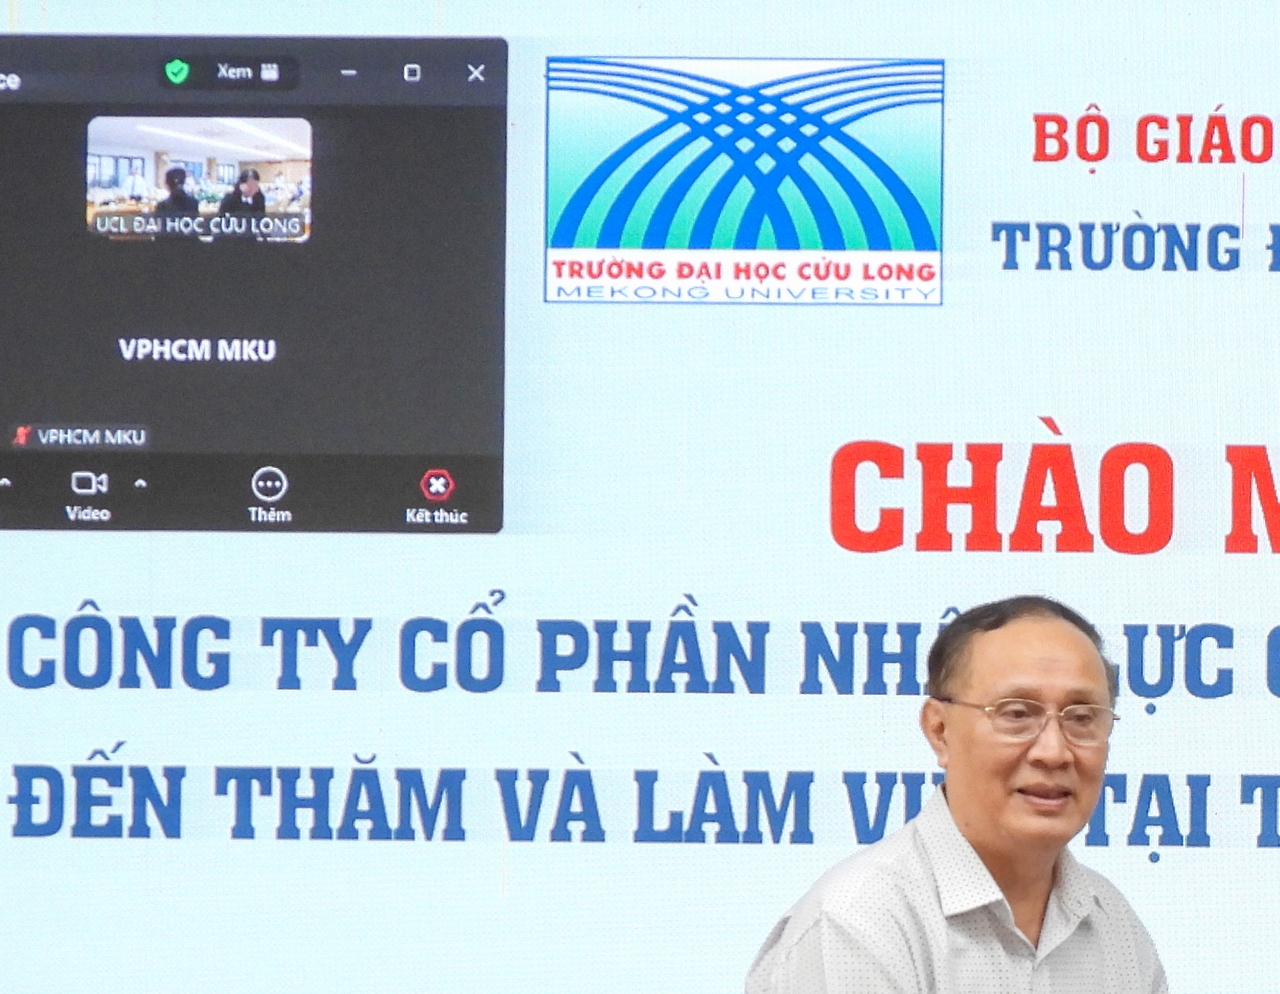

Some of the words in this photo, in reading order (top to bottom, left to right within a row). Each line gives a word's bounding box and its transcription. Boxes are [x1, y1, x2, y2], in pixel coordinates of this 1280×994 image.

[217, 63, 253, 80] Xem
[1033, 104, 1110, 174] BỘ
[1136, 105, 1274, 164] GIÁO
[96, 216, 127, 233] UCL
[251, 217, 301, 233] LONG
[992, 210, 1241, 272] TRƯỜNG
[552, 256, 666, 280] TRƯỜNG
[676, 261, 722, 285] ĐẠI
[733, 262, 787, 283] HỌC
[797, 257, 851, 282] CỬU
[862, 263, 937, 282] LONG
[556, 285, 710, 300] MEKONG
[725, 286, 938, 301] UNIVERSITY
[118, 337, 211, 362] VPHCM
[217, 338, 277, 362] MKU
[37, 428, 101, 445] VPHCM
[104, 429, 147, 446] MKU
[830, 416, 1174, 555] CHÀO
[65, 505, 112, 521] Video
[248, 506, 293, 522] Thêm
[8, 599, 231, 691] CÔNG
[262, 617, 373, 691] TY
[400, 589, 506, 693] CỔ
[537, 594, 771, 694] PHẦN
[801, 606, 958, 695] NH
[1108, 623, 1234, 715] ỰC
[8, 741, 187, 840] ĐẾN
[215, 753, 467, 842] THĂM
[495, 752, 606, 843] VÀ
[634, 753, 815, 845] LÀM
[1085, 773, 1212, 863] TẠI
